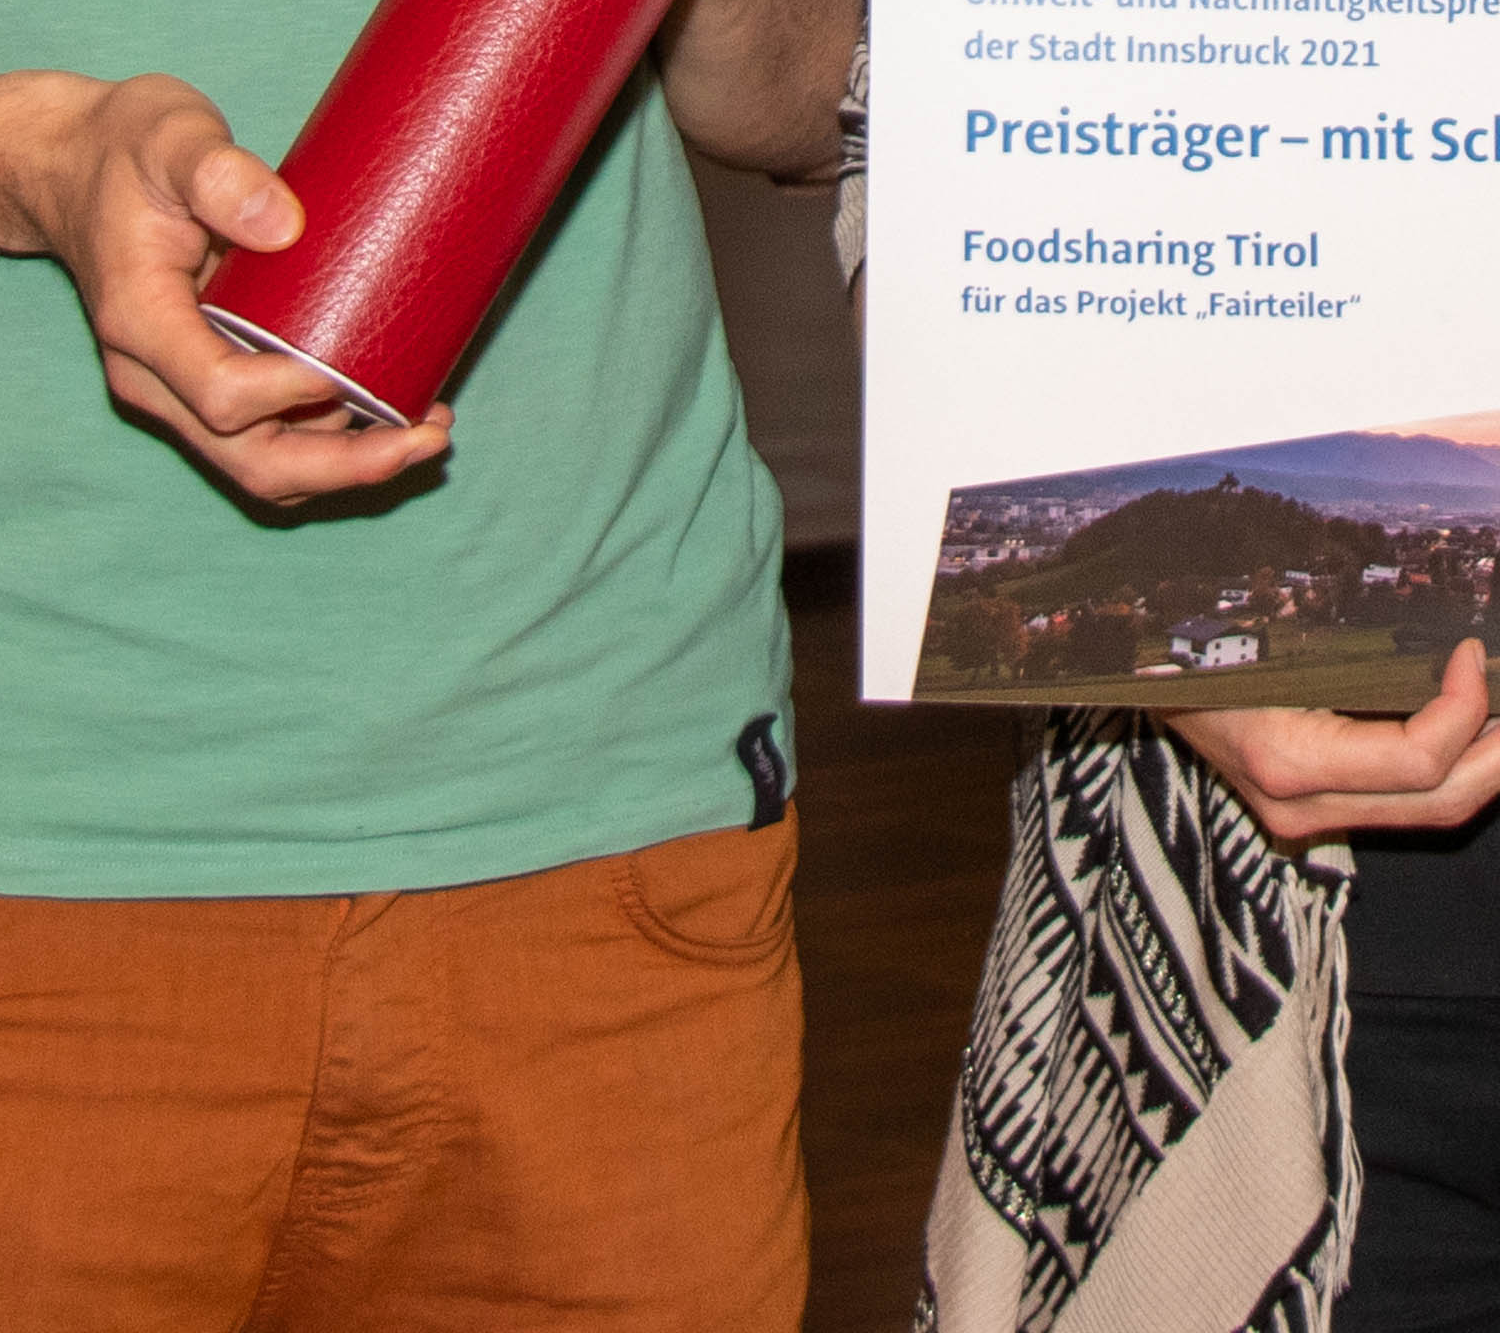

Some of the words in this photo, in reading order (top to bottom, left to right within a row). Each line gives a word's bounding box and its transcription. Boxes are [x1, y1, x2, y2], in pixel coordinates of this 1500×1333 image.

[965, 31, 1018, 60] der
[1030, 32, 1116, 62] Stadt
[1128, 34, 1290, 65] Innsbruck
[1301, 39, 1381, 67] 2021
[967, 107, 1269, 173] Preisträger
[1323, 112, 1413, 162] mit
[964, 229, 1216, 277] Foodsharing
[1227, 232, 1318, 267] Tirol
[961, 286, 1005, 313] für
[1015, 287, 1067, 315] das
[1078, 289, 1187, 323] Projekt
